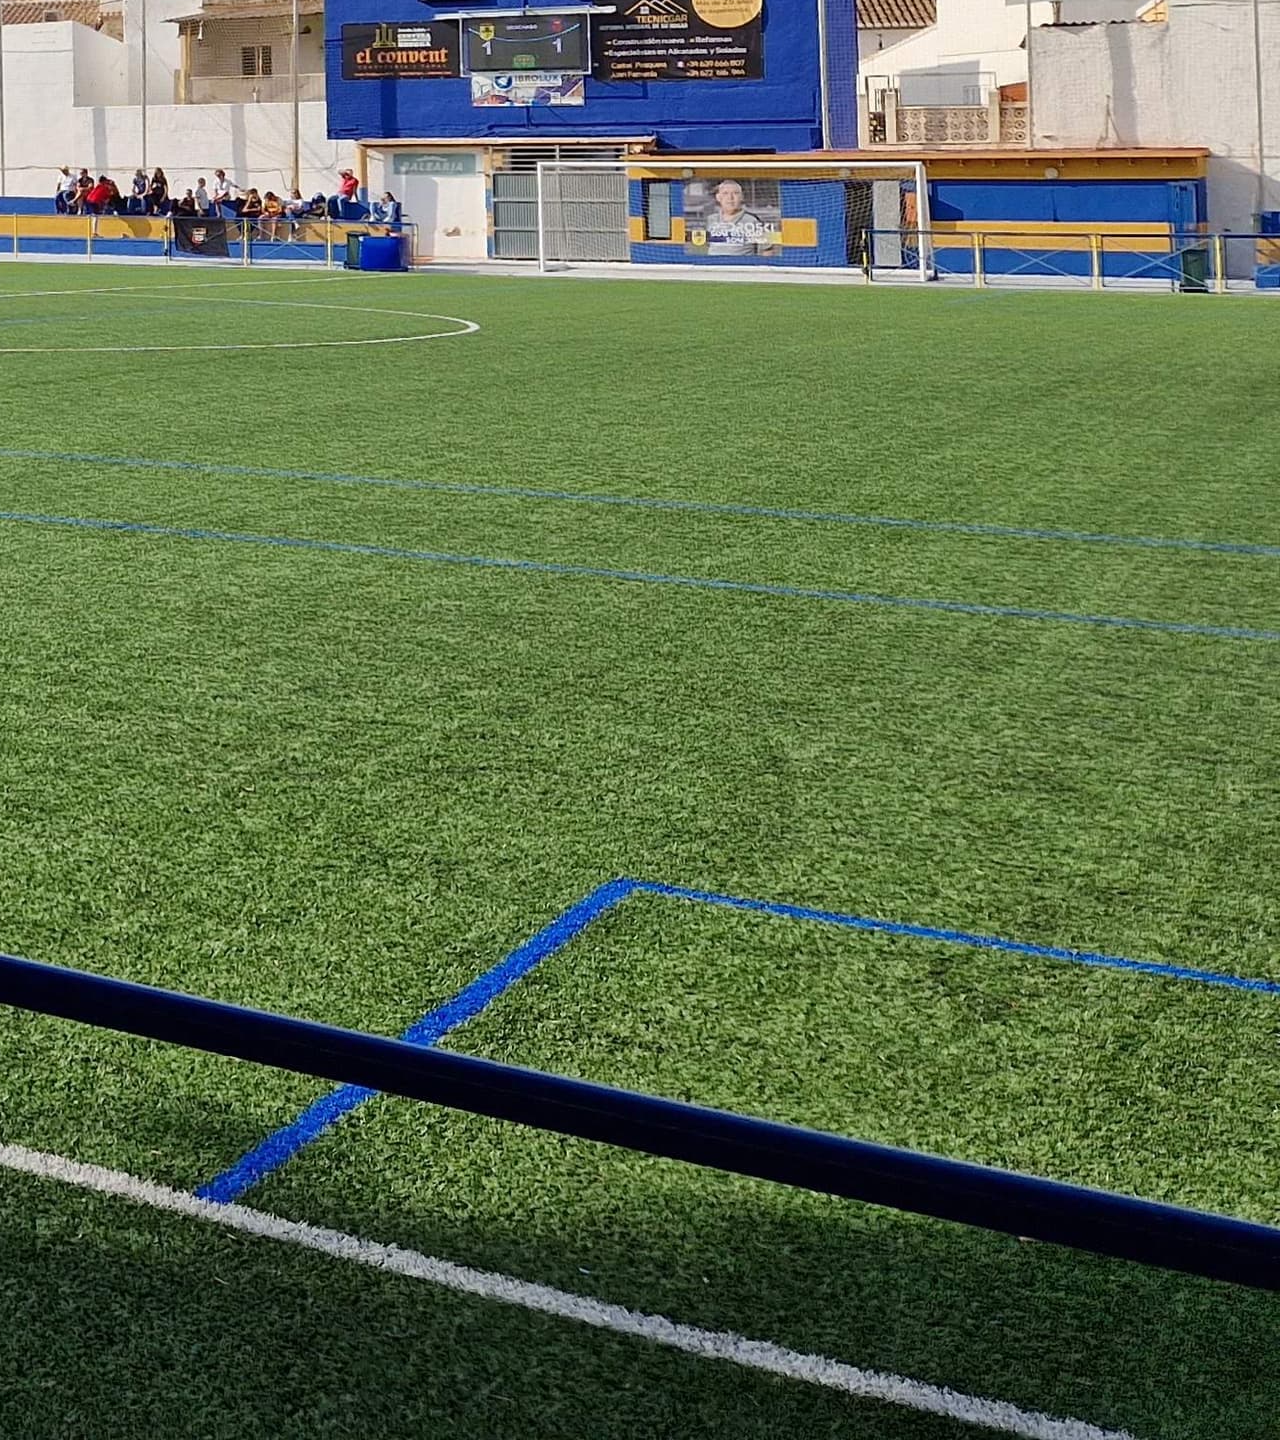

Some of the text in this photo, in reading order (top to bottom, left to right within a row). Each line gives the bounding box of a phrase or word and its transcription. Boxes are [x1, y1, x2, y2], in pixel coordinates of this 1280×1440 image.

[482, 41, 492, 55] 1
[552, 38, 562, 53] 1
[355, 47, 449, 64] el convent
